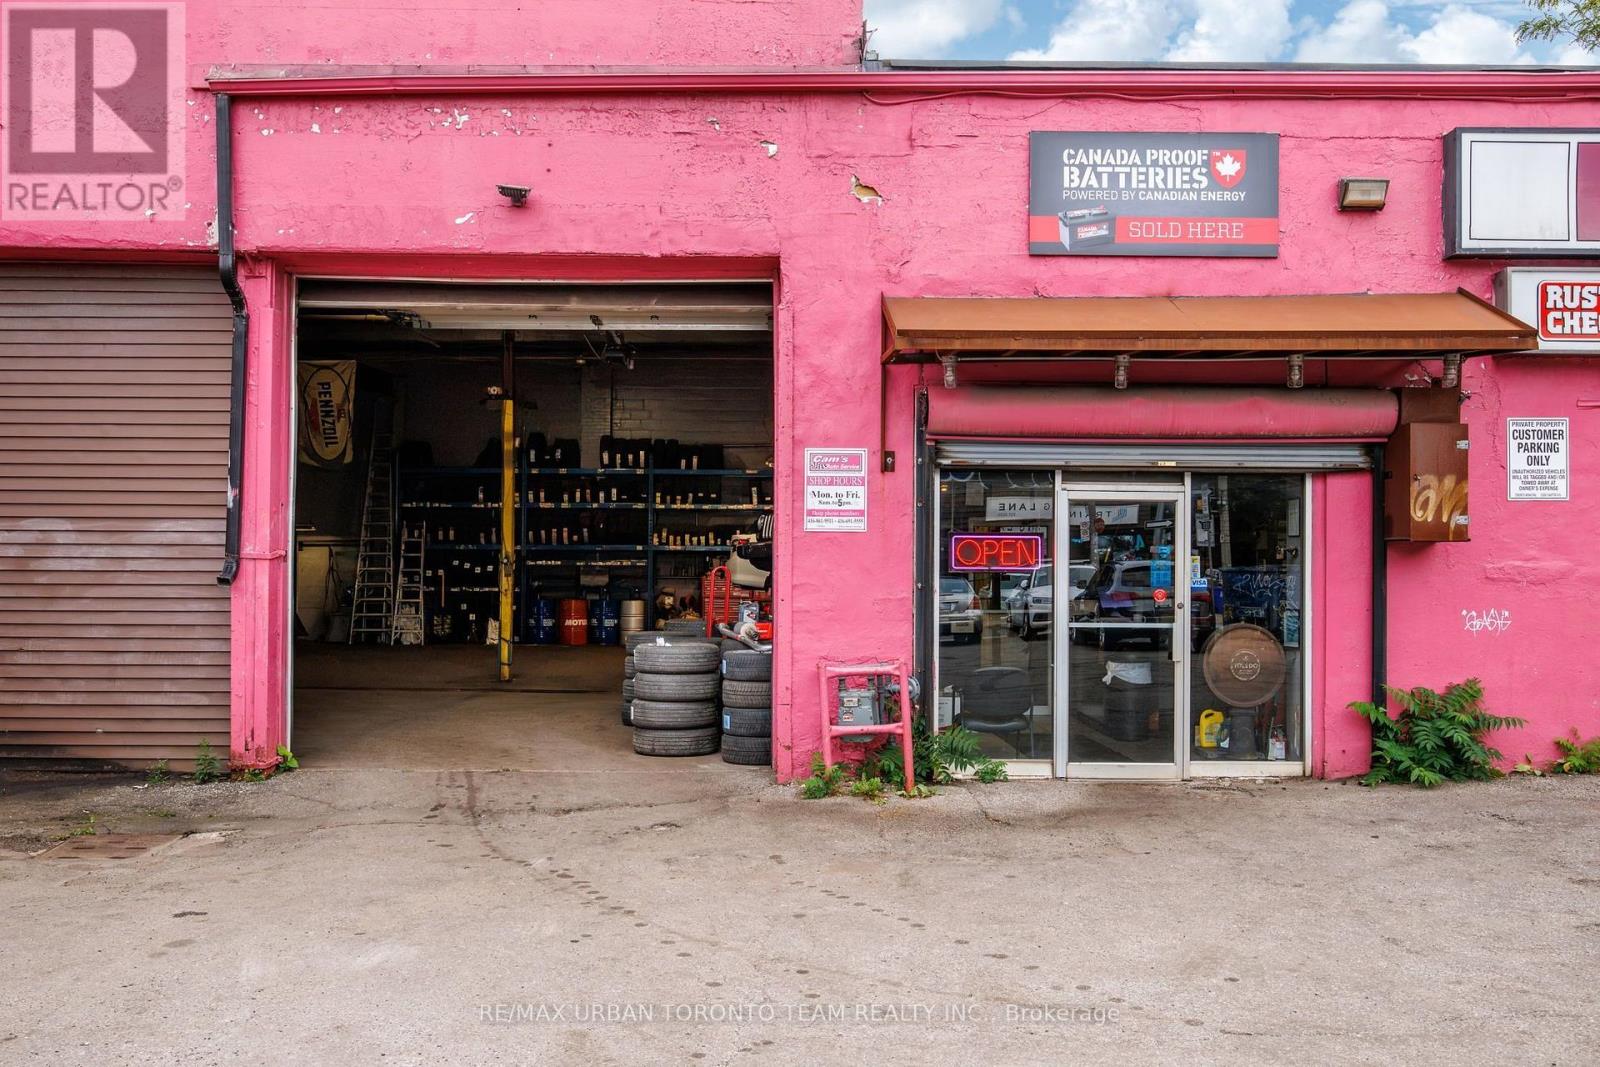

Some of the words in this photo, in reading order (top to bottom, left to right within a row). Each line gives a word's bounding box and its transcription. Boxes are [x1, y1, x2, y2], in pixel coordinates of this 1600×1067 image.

[1063, 149, 1142, 166] CANADA
[1146, 149, 1208, 167] PROOF
[1063, 167, 1208, 189] BATTERIES
[1062, 190, 1117, 201] POWERED
[1121, 190, 1136, 201] BY
[1138, 190, 1198, 201] CANADIAN
[1200, 191, 1247, 202] ENERGY
[1128, 221, 1182, 239] SOLD
[1187, 222, 1244, 240] HERE
[1546, 285, 1600, 309] RUS
[1546, 311, 1600, 334] CHE
[317, 381, 339, 448] PENNZOIL
[1512, 429, 1565, 440] CUSTOMER
[1517, 442, 1560, 453] PARKING
[1526, 455, 1551, 466] ONLY
[808, 477, 833, 486] SHOP
[834, 477, 863, 486] HOURS
[811, 490, 833, 498] Mon.
[846, 490, 861, 498] Fri.
[956, 539, 1037, 566] OPEN
[564, 618, 589, 626] MOTU
